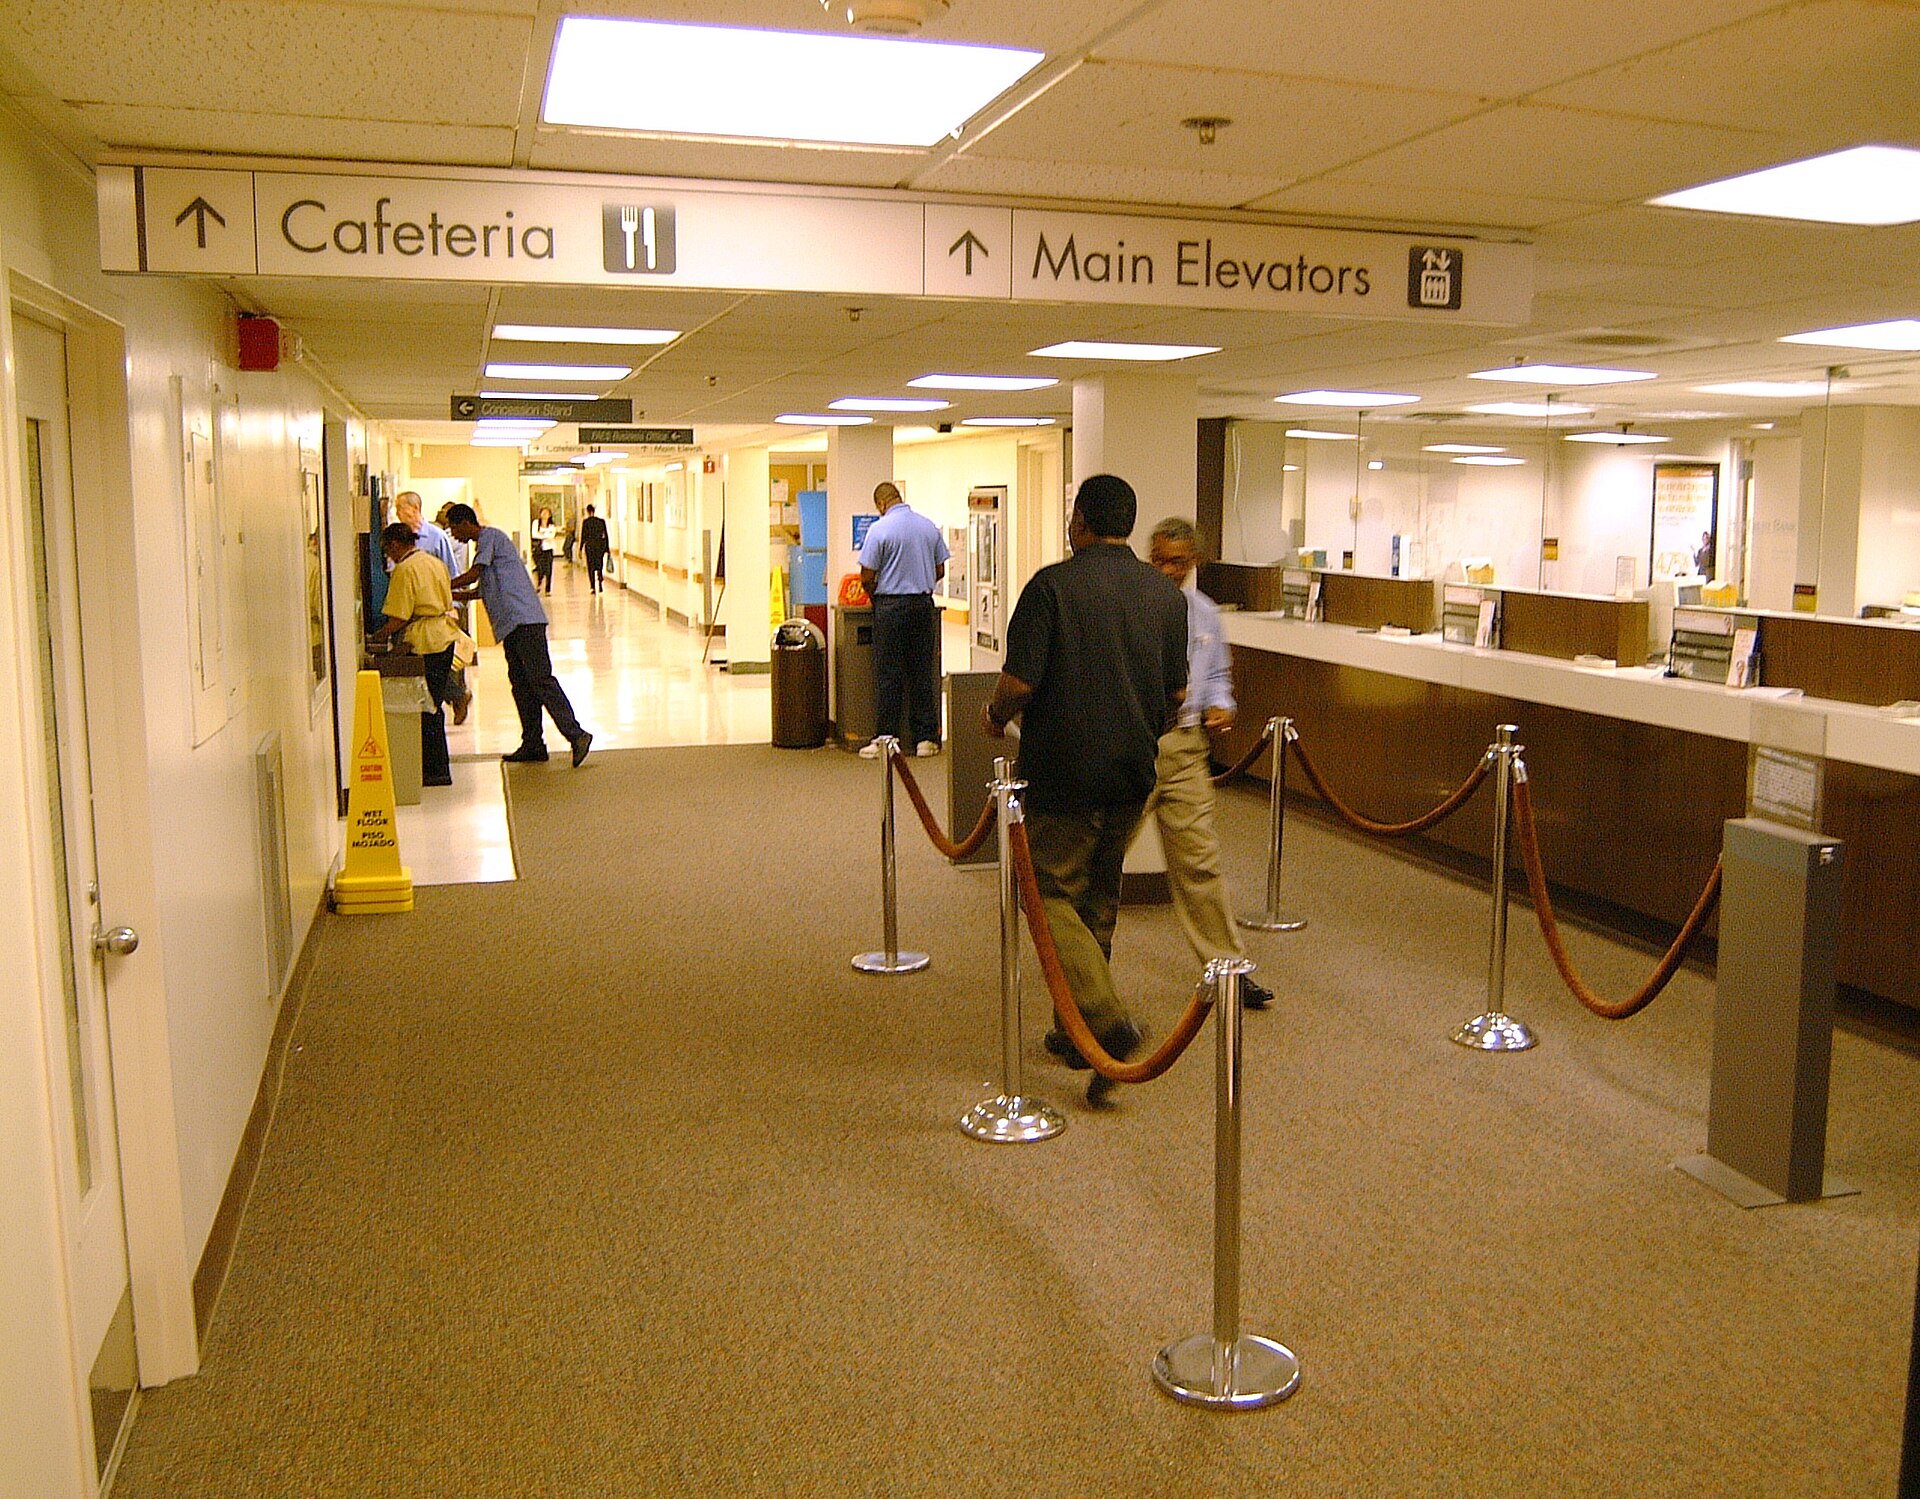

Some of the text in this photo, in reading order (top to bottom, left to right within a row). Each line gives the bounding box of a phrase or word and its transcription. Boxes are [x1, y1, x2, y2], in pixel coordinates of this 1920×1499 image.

[281, 197, 555, 261] Cafeteria
[1032, 231, 1371, 297] Main Elevators
[357, 819, 387, 827] FLOOR
[352, 840, 395, 848] MOJADO
